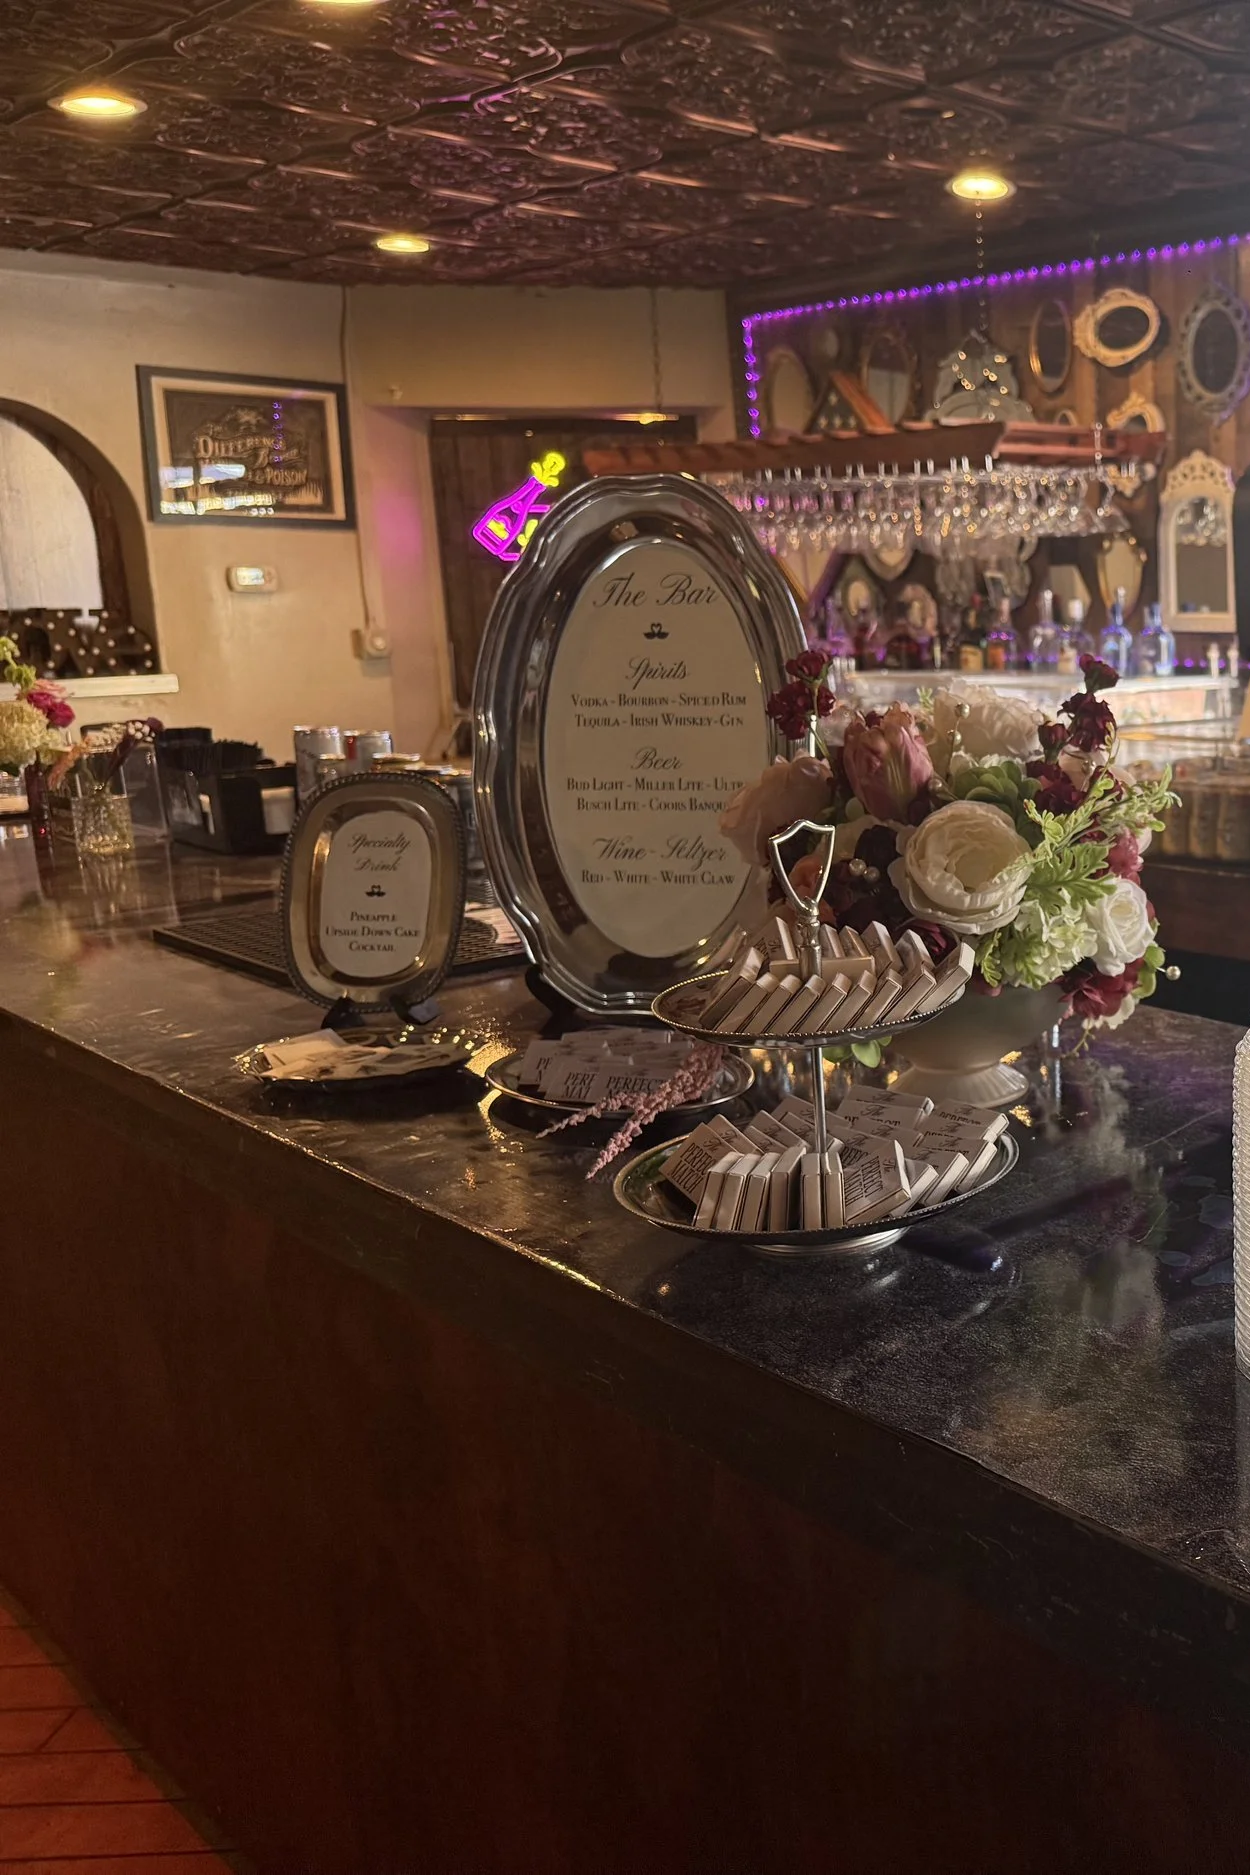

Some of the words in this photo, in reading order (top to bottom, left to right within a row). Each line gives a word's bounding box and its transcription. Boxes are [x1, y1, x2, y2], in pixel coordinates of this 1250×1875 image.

[265, 465, 308, 487] POISON
[592, 572, 646, 607] The
[655, 573, 721, 607] Bar
[625, 656, 689, 690] Spirits
[630, 746, 683, 771] Beer
[714, 777, 746, 792] ULTR
[689, 798, 728, 814] BANQU
[348, 834, 411, 854] Specialty
[592, 834, 647, 861] Wine
[661, 835, 727, 874] Seltzer
[353, 857, 400, 872] Drink
